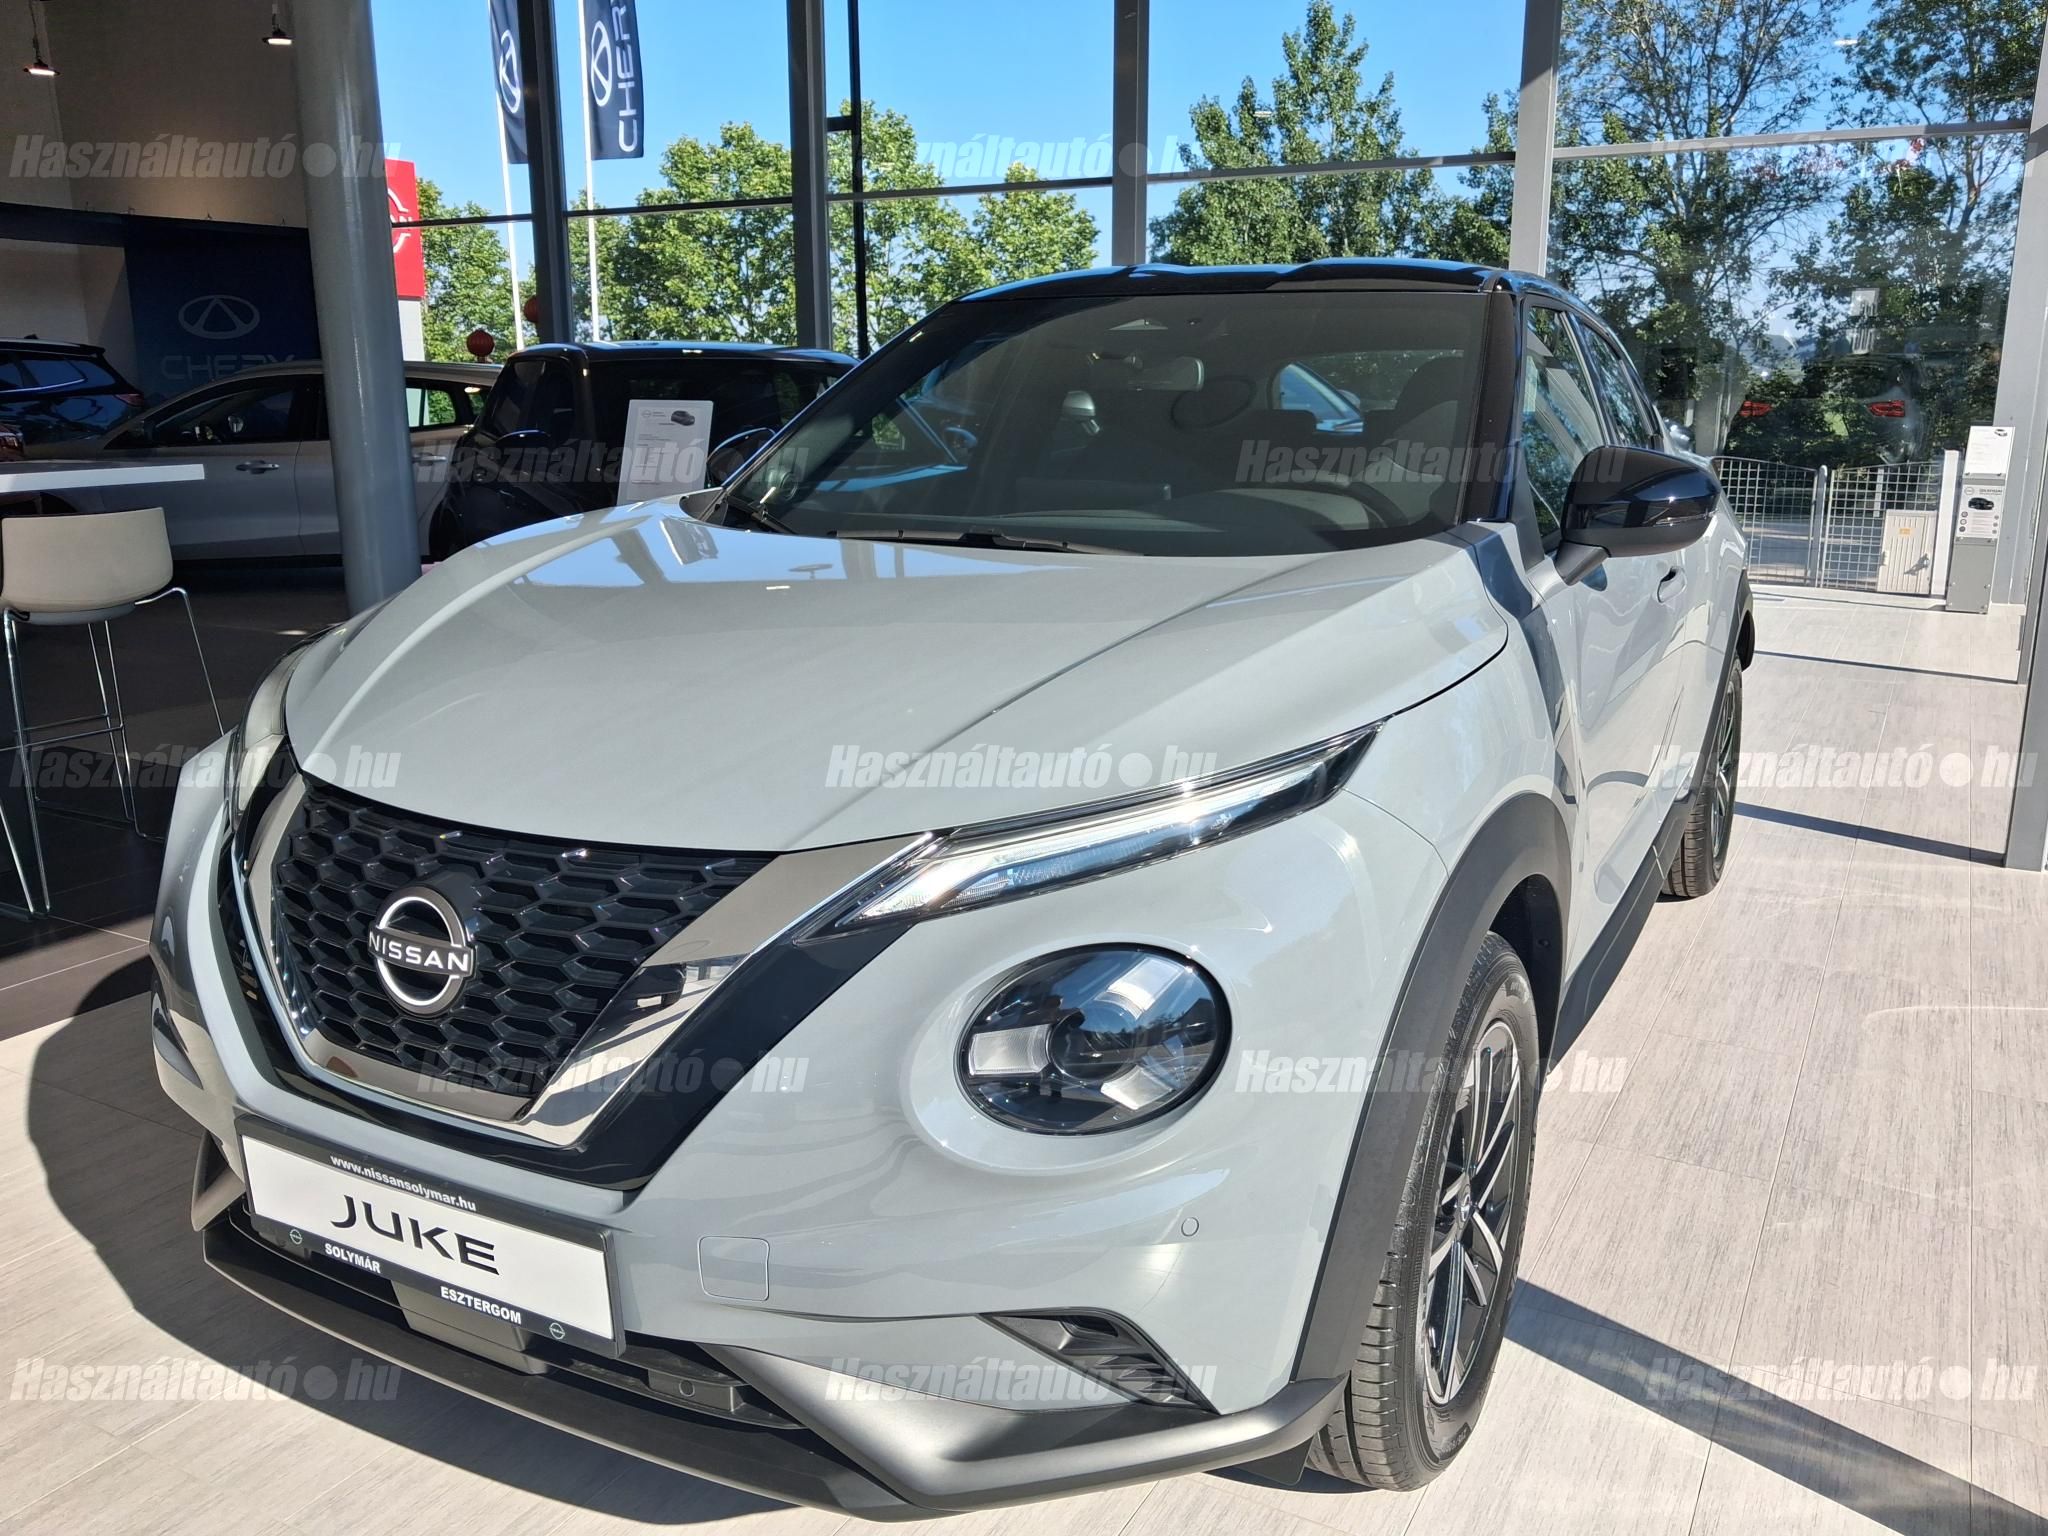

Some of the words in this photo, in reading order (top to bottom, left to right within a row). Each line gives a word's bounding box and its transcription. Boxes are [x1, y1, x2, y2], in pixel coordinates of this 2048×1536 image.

[611, 0, 638, 152] CHER
[368, 931, 470, 972] NISSAN
[330, 1155, 477, 1212] www.nissansolymar.hu
[325, 1243, 381, 1273] SOLYMÁR
[331, 1195, 499, 1275] JUKE
[440, 1286, 522, 1325] ESZTERGOM
